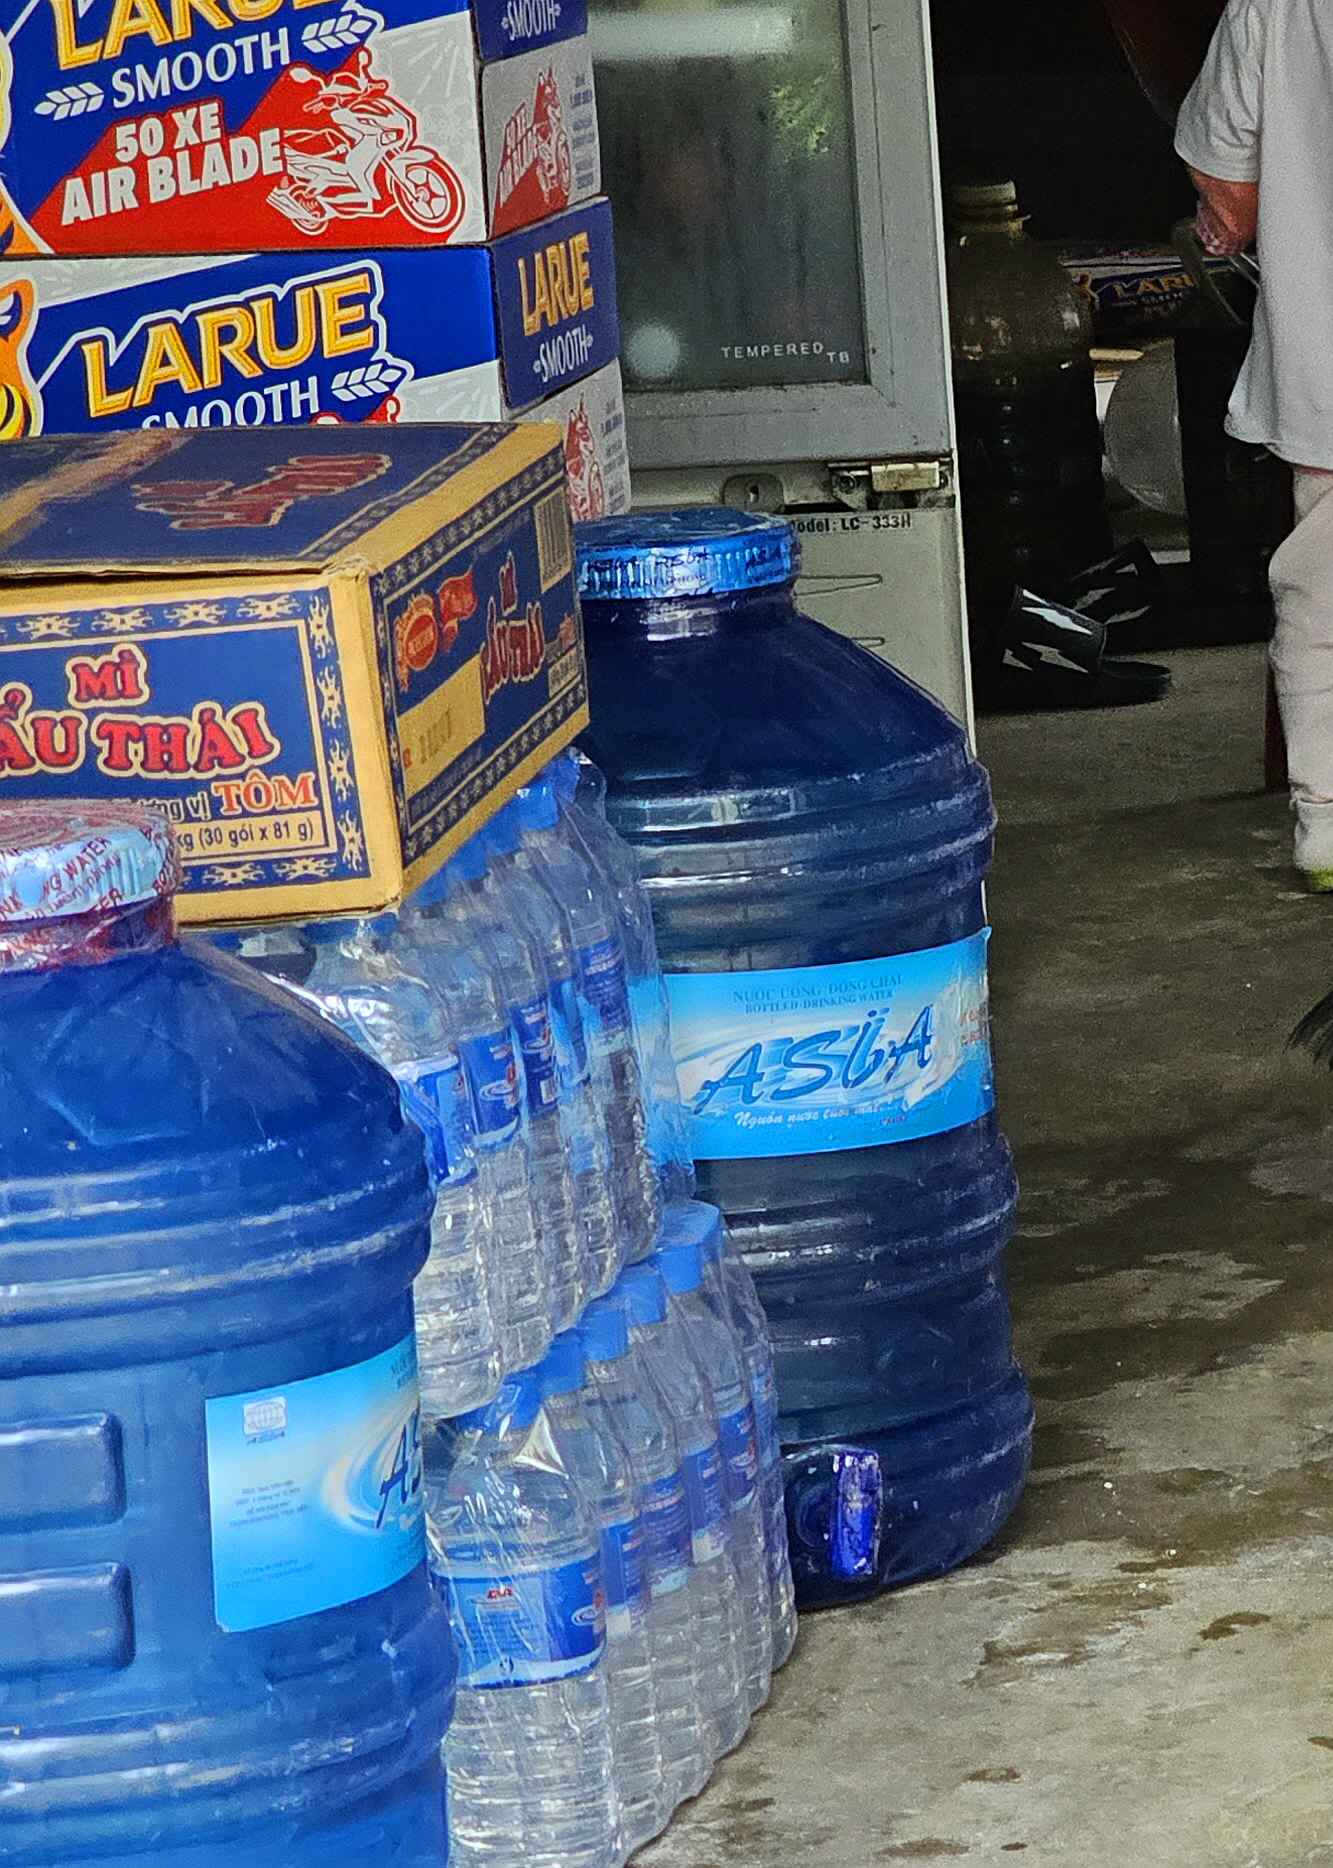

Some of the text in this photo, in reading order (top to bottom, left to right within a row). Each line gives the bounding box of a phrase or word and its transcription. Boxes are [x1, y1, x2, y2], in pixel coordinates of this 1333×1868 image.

[508, 0, 556, 41] SMOOTH
[112, 27, 289, 108] SMOOTH
[115, 103, 222, 163] 50 XE
[61, 129, 285, 226] AIR BLADE
[518, 231, 594, 336] LARUE
[81, 272, 378, 418] LARUE
[540, 323, 588, 382] SMOOTH
[721, 341, 824, 359] TEMPERED
[75, 650, 142, 701] MÌ
[213, 772, 317, 813] TÔM
[199, 826, 223, 851] (30
[259, 827, 269, 841] x
[273, 820, 291, 840] 81
[745, 988, 895, 1015] BOTTLED DRINKING WATER
